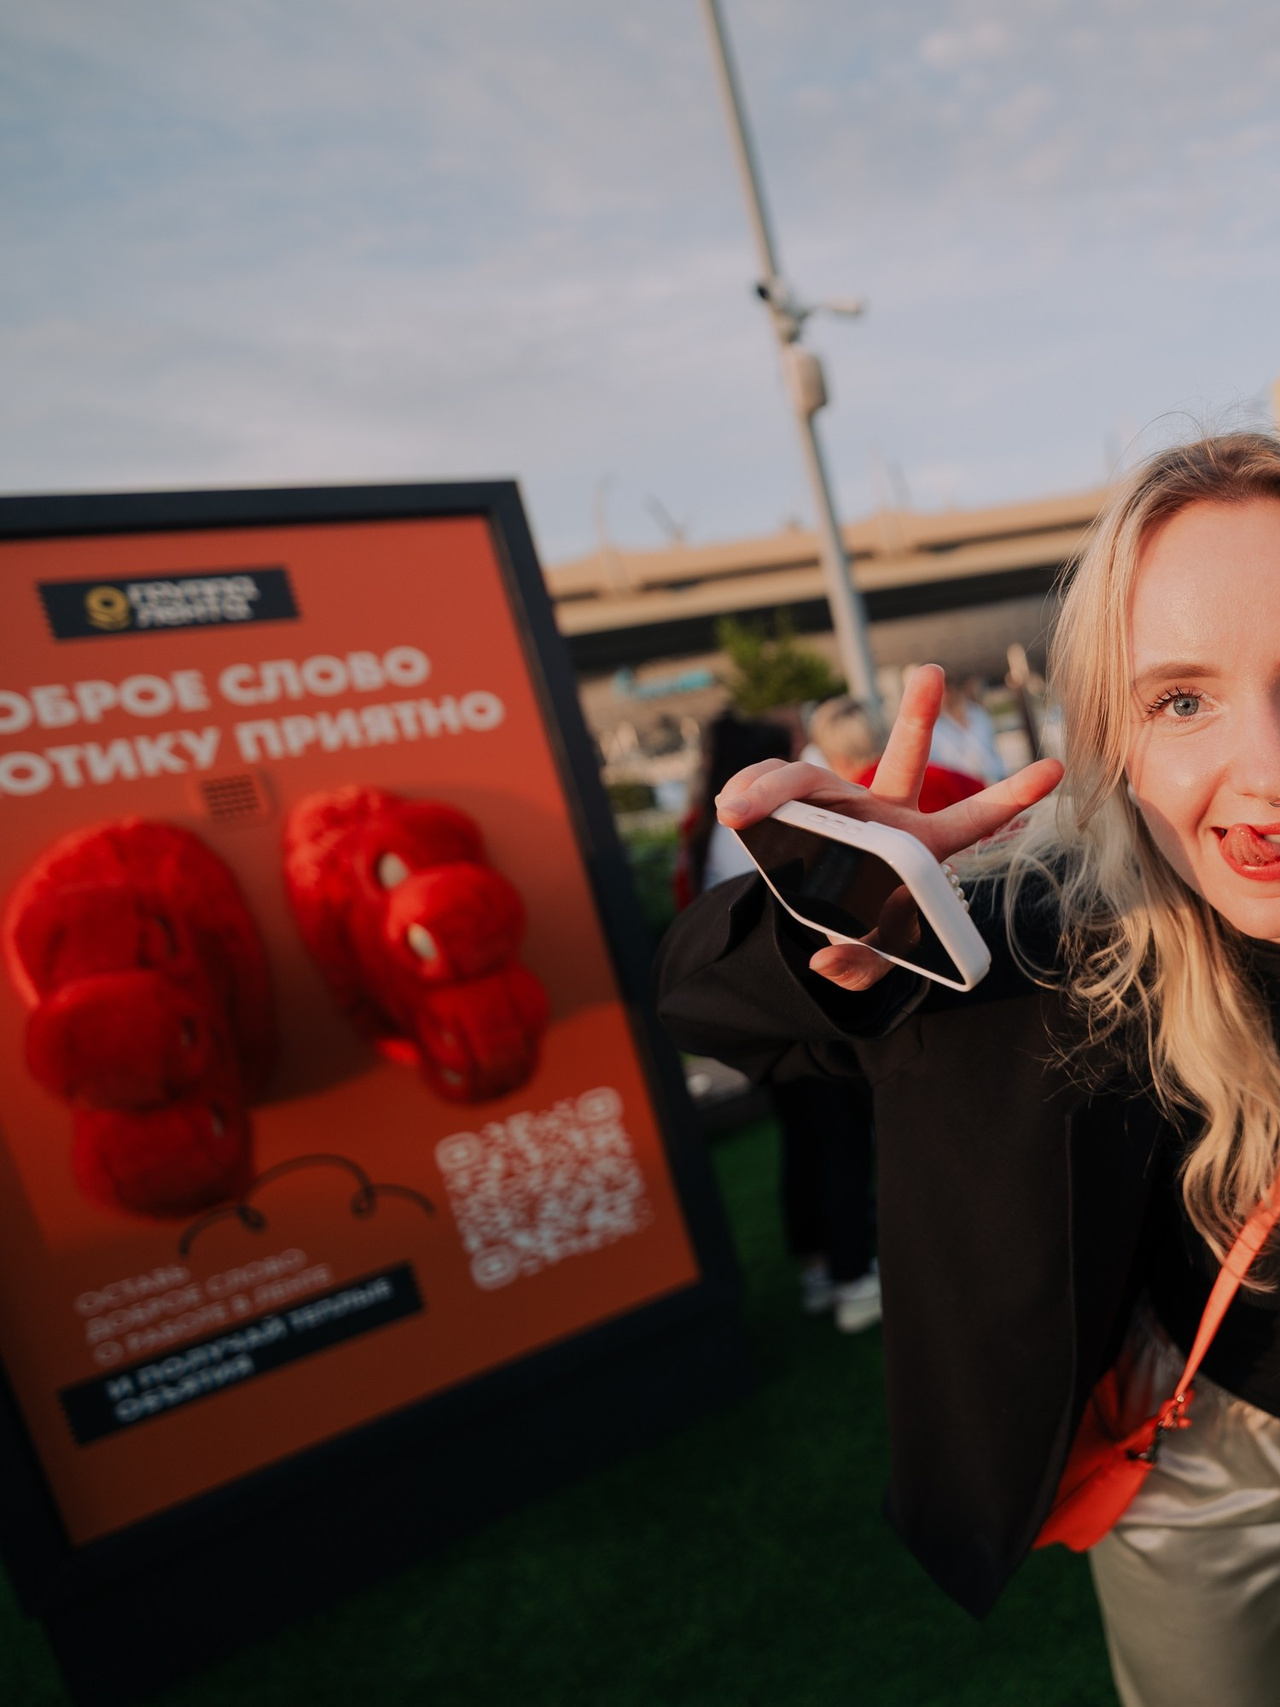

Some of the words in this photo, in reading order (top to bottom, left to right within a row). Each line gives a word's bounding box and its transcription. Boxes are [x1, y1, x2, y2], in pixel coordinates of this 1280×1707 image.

[218, 645, 431, 706] СЛОВО
[234, 690, 505, 764] ПРИЯТНО
[205, 1248, 307, 1299] СЛОВО
[106, 1374, 135, 1400] И
[136, 1314, 288, 1386] ПОЛУЧАЙ
